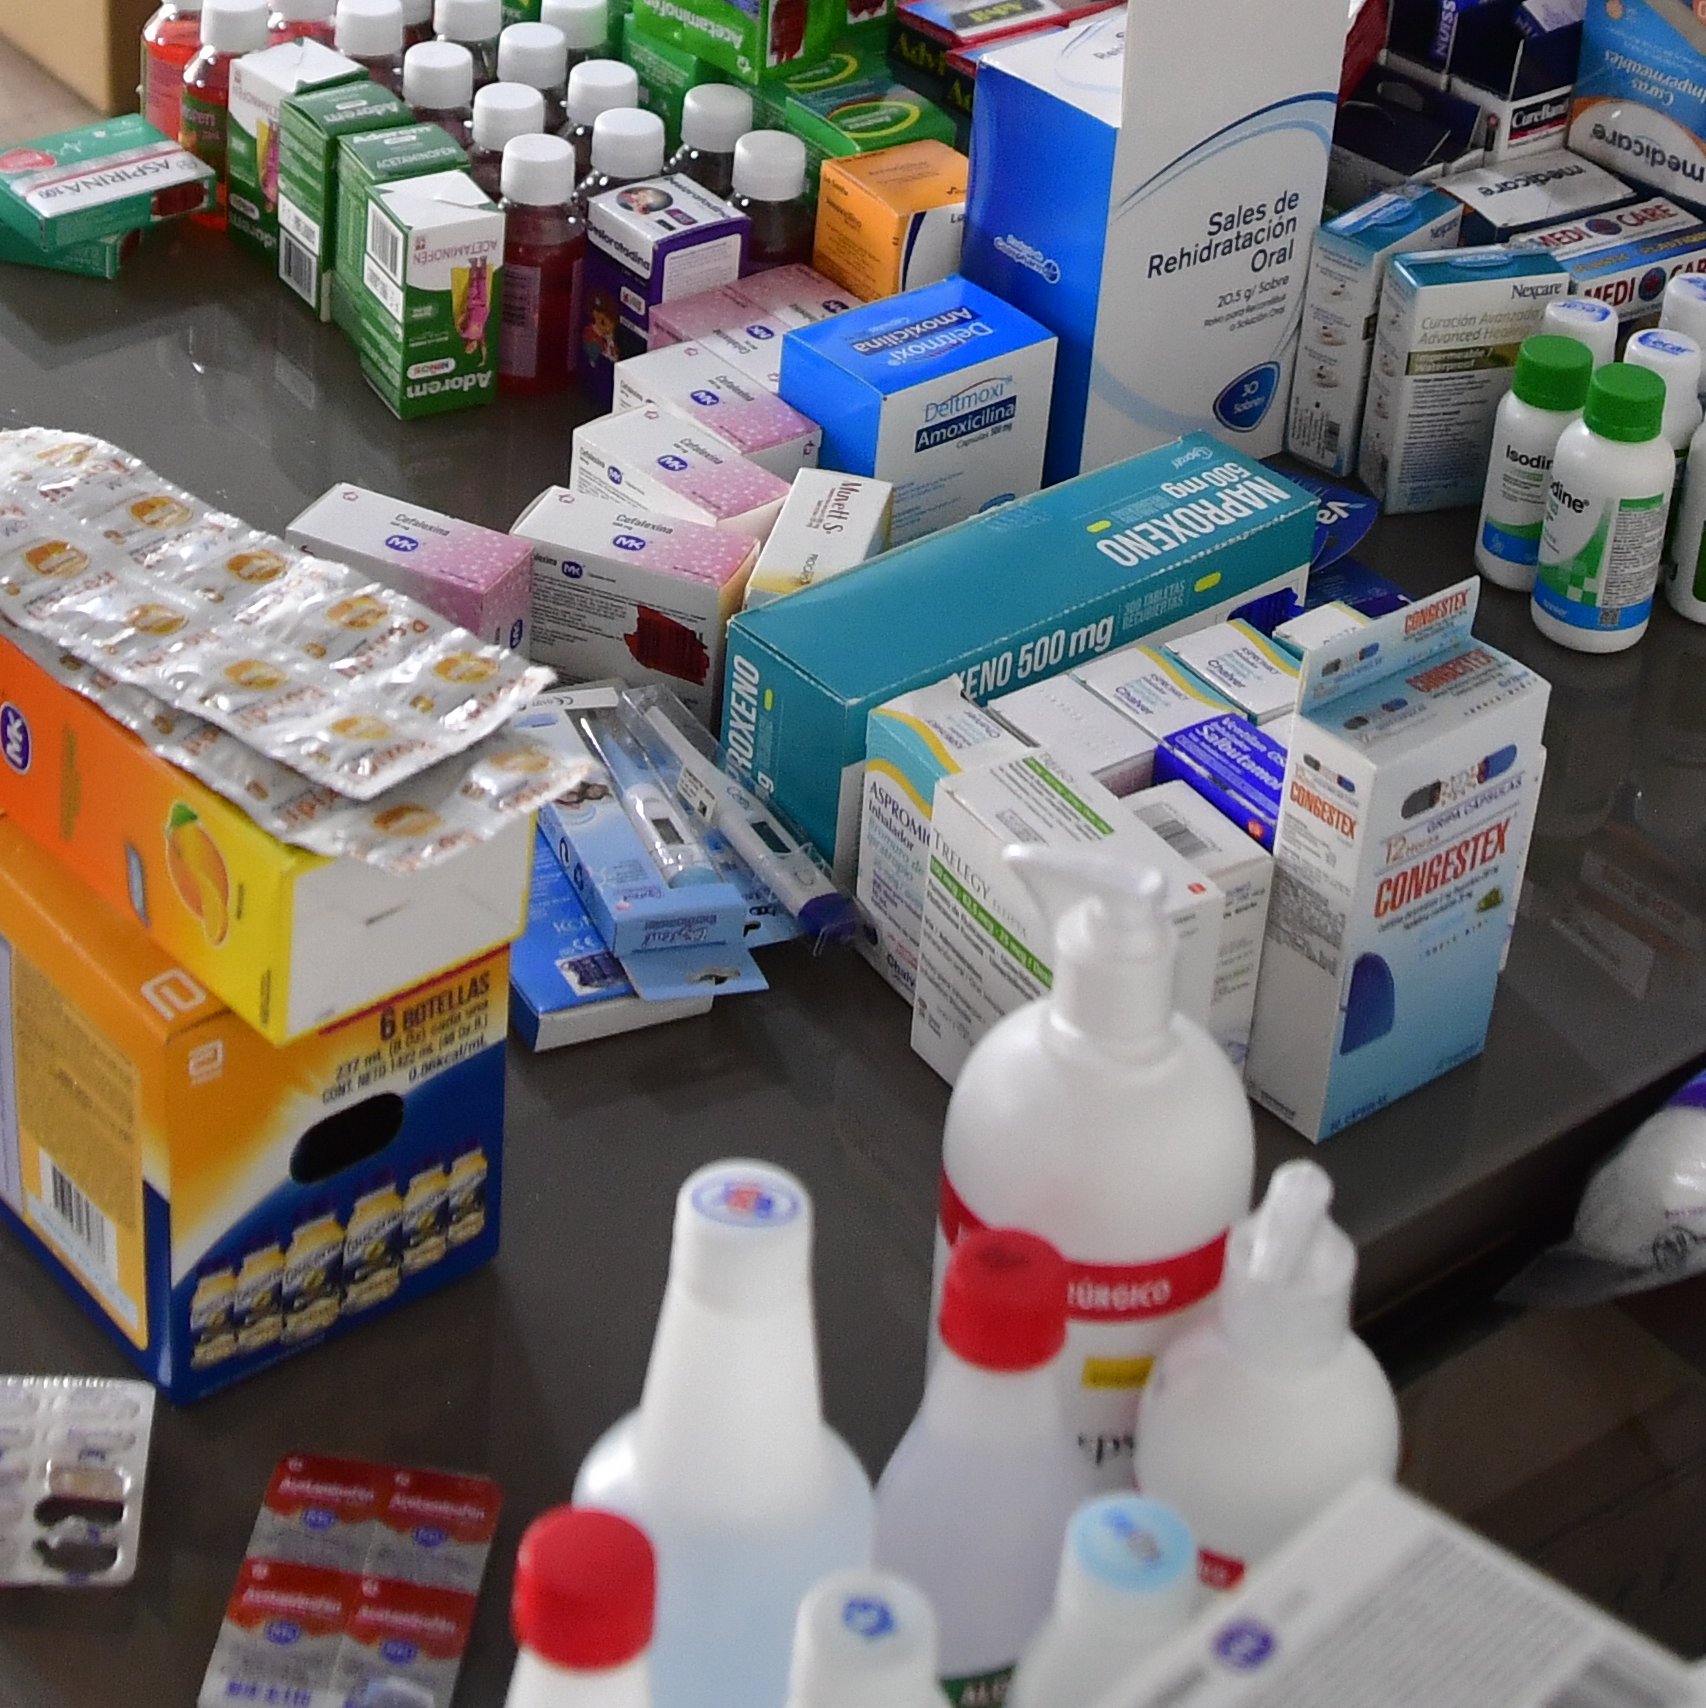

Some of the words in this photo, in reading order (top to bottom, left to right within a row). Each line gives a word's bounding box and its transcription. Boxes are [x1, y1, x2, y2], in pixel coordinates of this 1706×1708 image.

[1630, 77, 1675, 107] Curas
[323, 99, 400, 124] Adorem
[1590, 121, 1706, 185] medicare
[59, 158, 171, 195] ASPIRINA
[1207, 200, 1270, 239] Sales
[1273, 189, 1302, 216] de
[1616, 202, 1679, 231] CARE
[1146, 213, 1299, 281] Rehidratación
[1249, 242, 1295, 275] Oral
[1216, 291, 1243, 310] 20.5
[1510, 282, 1564, 300] Nexcare
[1583, 277, 1638, 308] MEDI
[853, 307, 973, 353] Amoxicilina
[1417, 326, 1480, 345] Advanced
[1421, 312, 1478, 330] Curación
[889, 322, 995, 364] Deltmoxi
[405, 370, 493, 400] Adorem
[693, 390, 718, 405] MK
[923, 379, 1006, 423] Deltmoxi
[918, 399, 1016, 450] Amoxicilina
[660, 456, 686, 472] MK
[679, 437, 724, 466] Cefalexina
[1160, 476, 1209, 500] mg
[1201, 461, 1252, 488] 500
[394, 512, 451, 538] Cefalexina
[615, 513, 674, 538] Cefalexina
[1096, 476, 1292, 567] NAPROXENO
[388, 534, 418, 552] MK
[615, 535, 646, 551] MK
[563, 563, 583, 576] MK
[1404, 588, 1471, 635] CONGESTEX
[1016, 629, 1065, 677] 500
[1068, 615, 1114, 659] mg
[6, 709, 25, 767] MK
[1289, 779, 1357, 841] CONGESTEX
[868, 801, 915, 852] Inhalador
[933, 828, 991, 900] TRELEGY
[1384, 835, 1408, 866] 12
[1373, 817, 1513, 919] CONGESTEX
[379, 1006, 397, 1042] 6
[401, 970, 491, 1032] BOTELLAS
